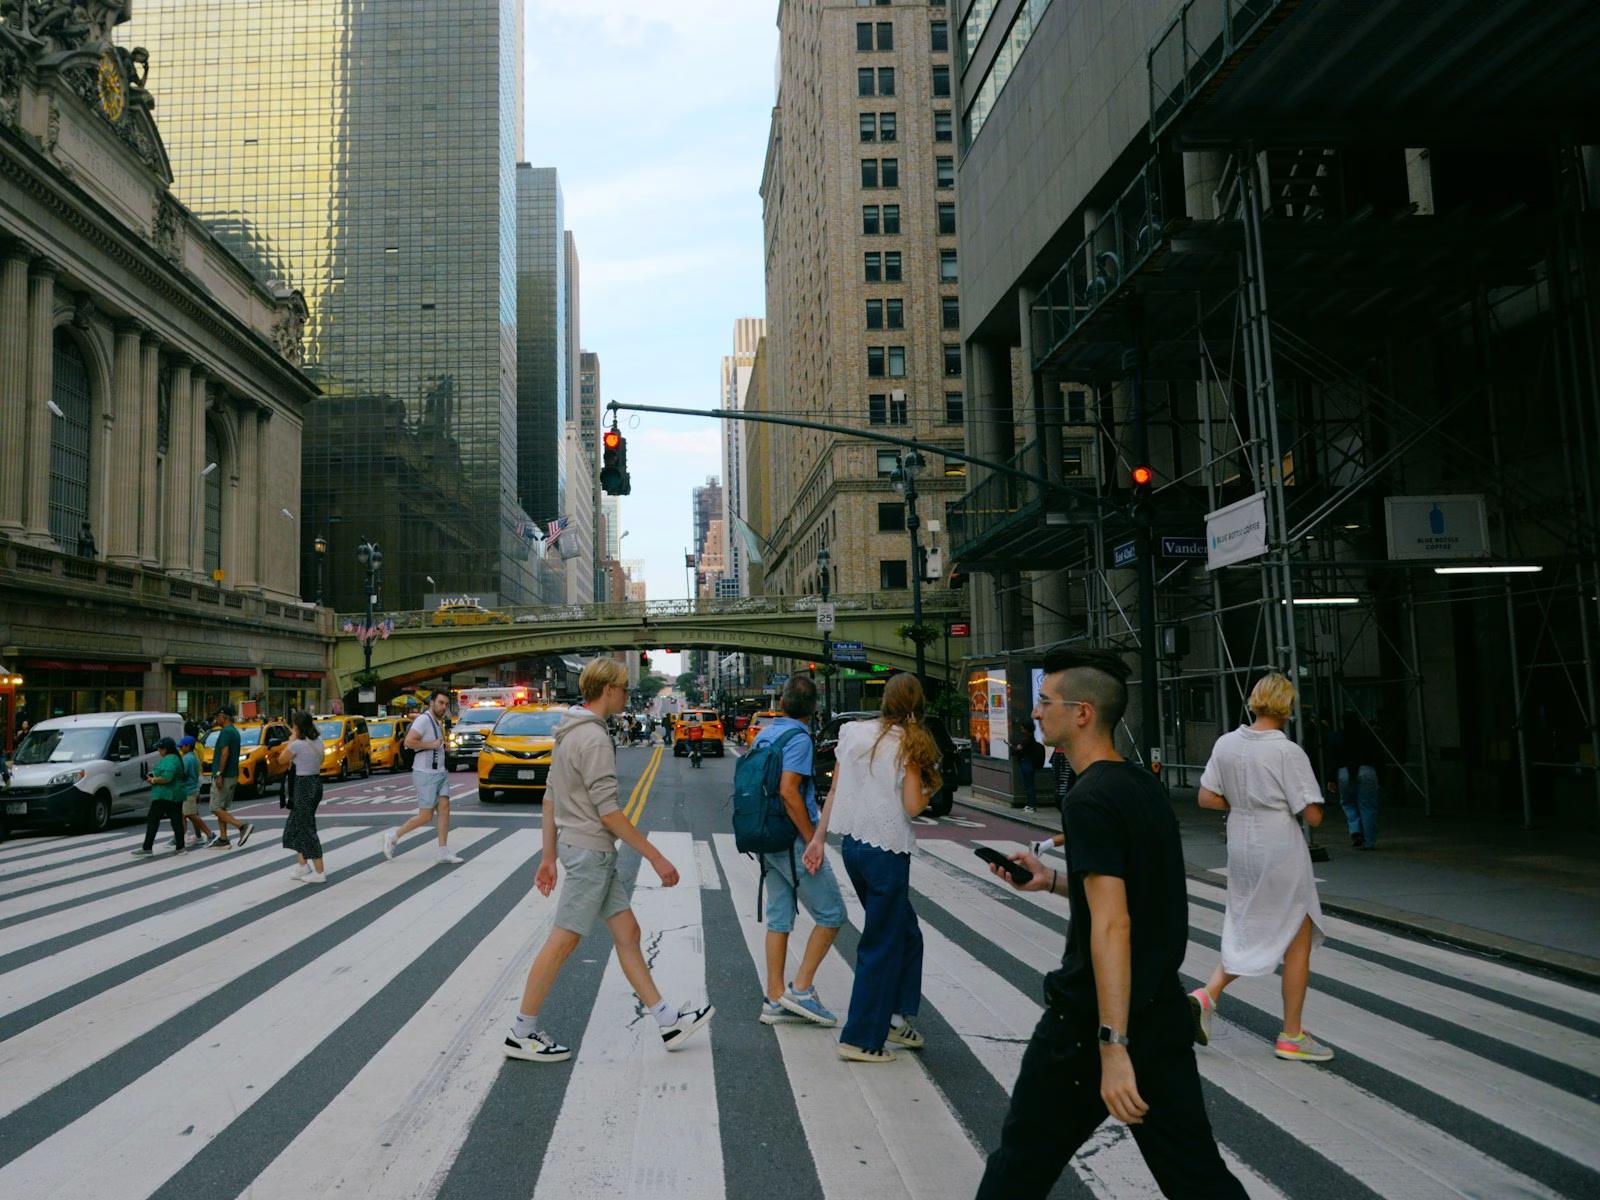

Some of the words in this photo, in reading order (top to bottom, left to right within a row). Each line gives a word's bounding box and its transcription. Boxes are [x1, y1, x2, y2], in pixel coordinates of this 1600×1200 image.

[1217, 534, 1227, 544] BLUE
[1228, 528, 1243, 540] BOTTLE
[1243, 521, 1260, 535] COFFEE
[1165, 541, 1208, 554] Vander
[440, 597, 480, 606] HYATT
[819, 614, 832, 622] 25
[681, 631, 746, 642] PERSHING
[754, 634, 804, 647] SQUARE
[425, 649, 469, 664] GRAND
[477, 639, 535, 654] CENTRAL
[543, 633, 609, 645] TERMINAL
